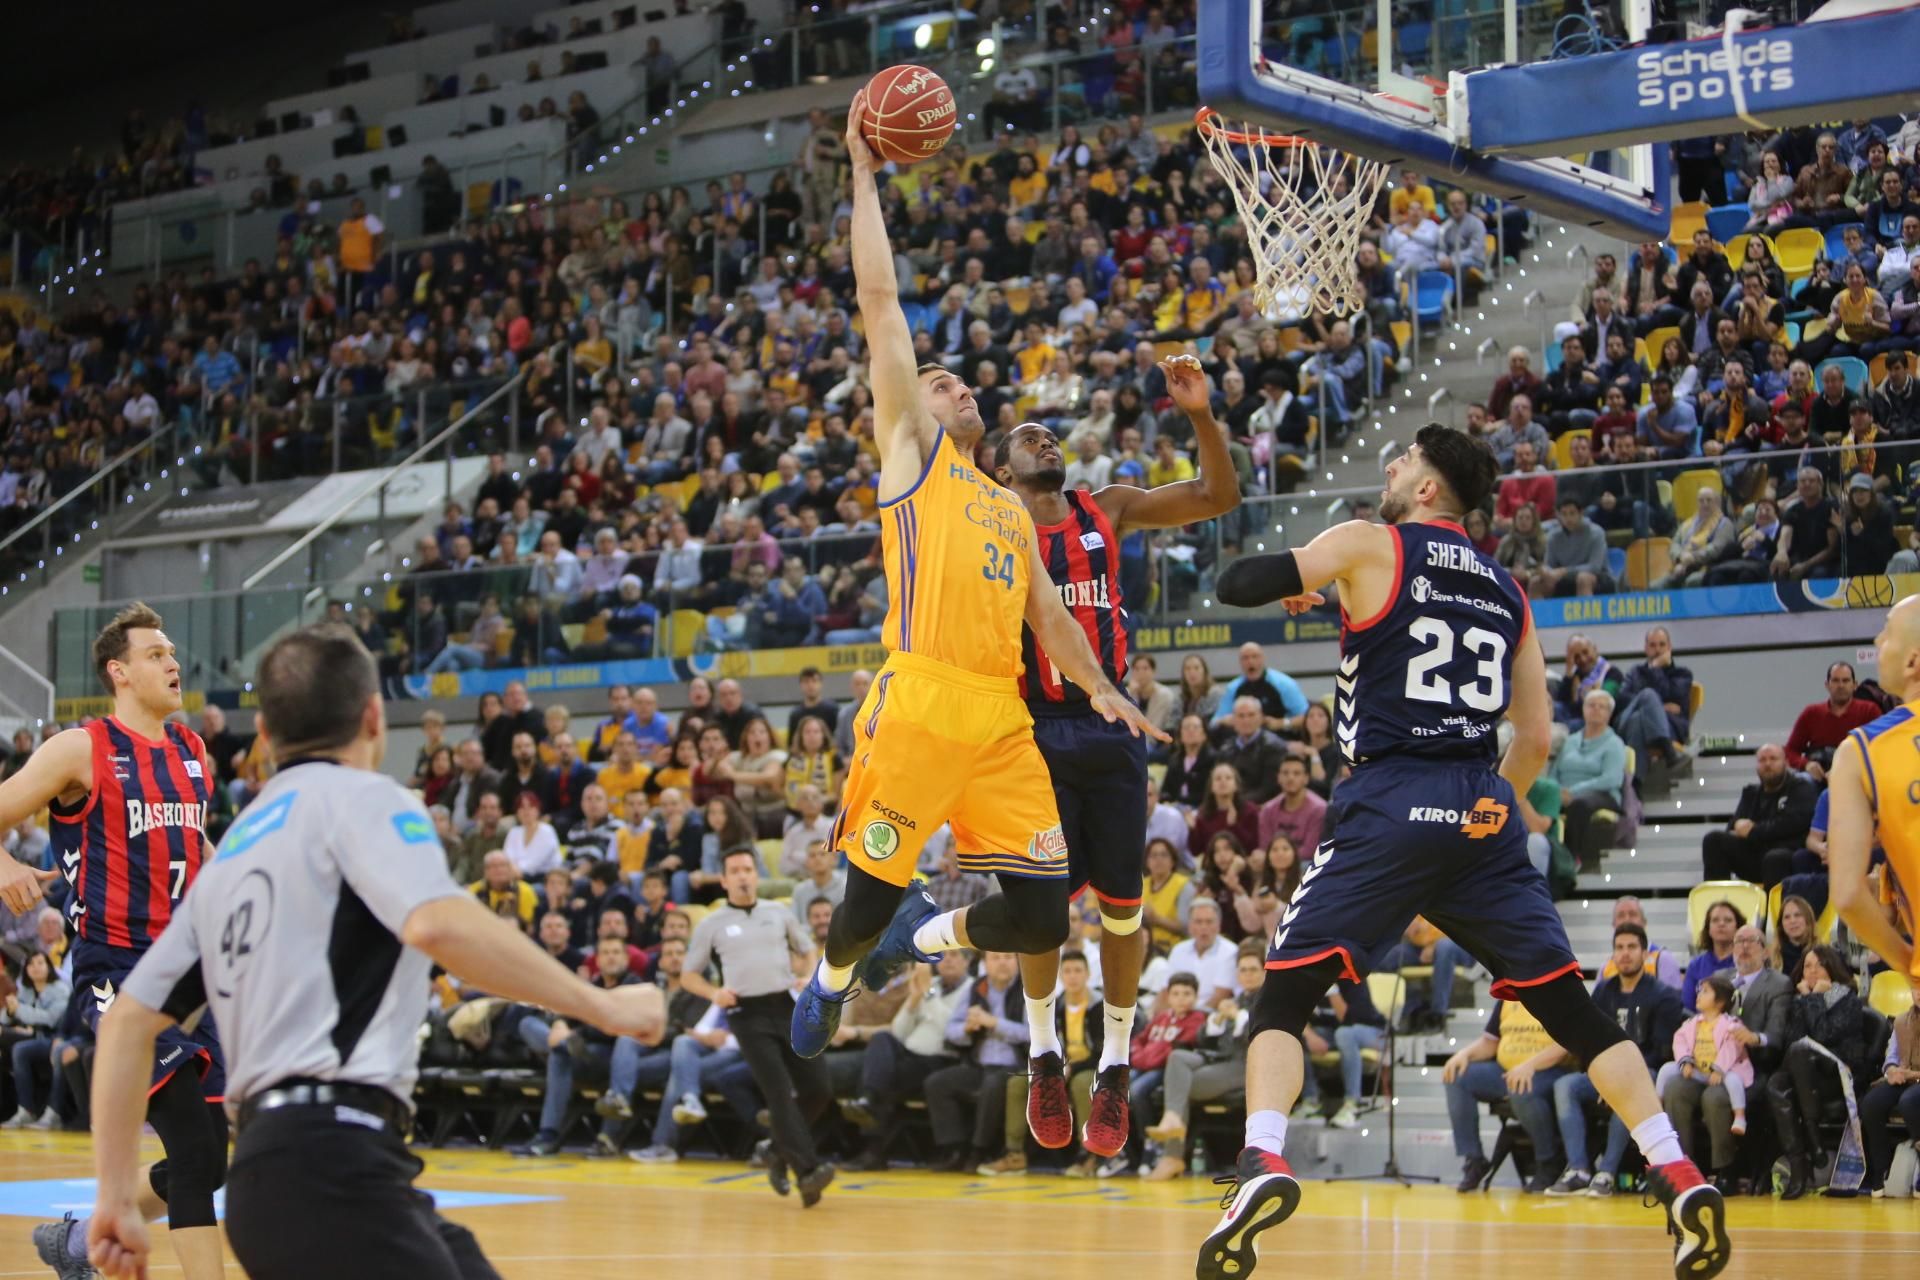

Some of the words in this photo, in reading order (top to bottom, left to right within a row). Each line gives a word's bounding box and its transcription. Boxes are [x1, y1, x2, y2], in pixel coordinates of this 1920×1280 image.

[1637, 38, 1793, 80] Schelde
[916, 98, 957, 128] SPALD
[982, 542, 1015, 591] 34
[1056, 573, 1113, 609] ONIA
[1431, 590, 1454, 602] Save
[1455, 594, 1473, 606] the
[1564, 600, 1602, 622] GRAN
[1607, 595, 1671, 619] CANARIA
[1135, 628, 1171, 649] GRAN
[1174, 624, 1231, 647] CANARIA
[1405, 615, 1508, 713] 23
[1442, 715, 1468, 726] visit
[1034, 829, 1066, 859] Kalis
[169, 860, 187, 899] 7
[220, 899, 254, 968] 42
